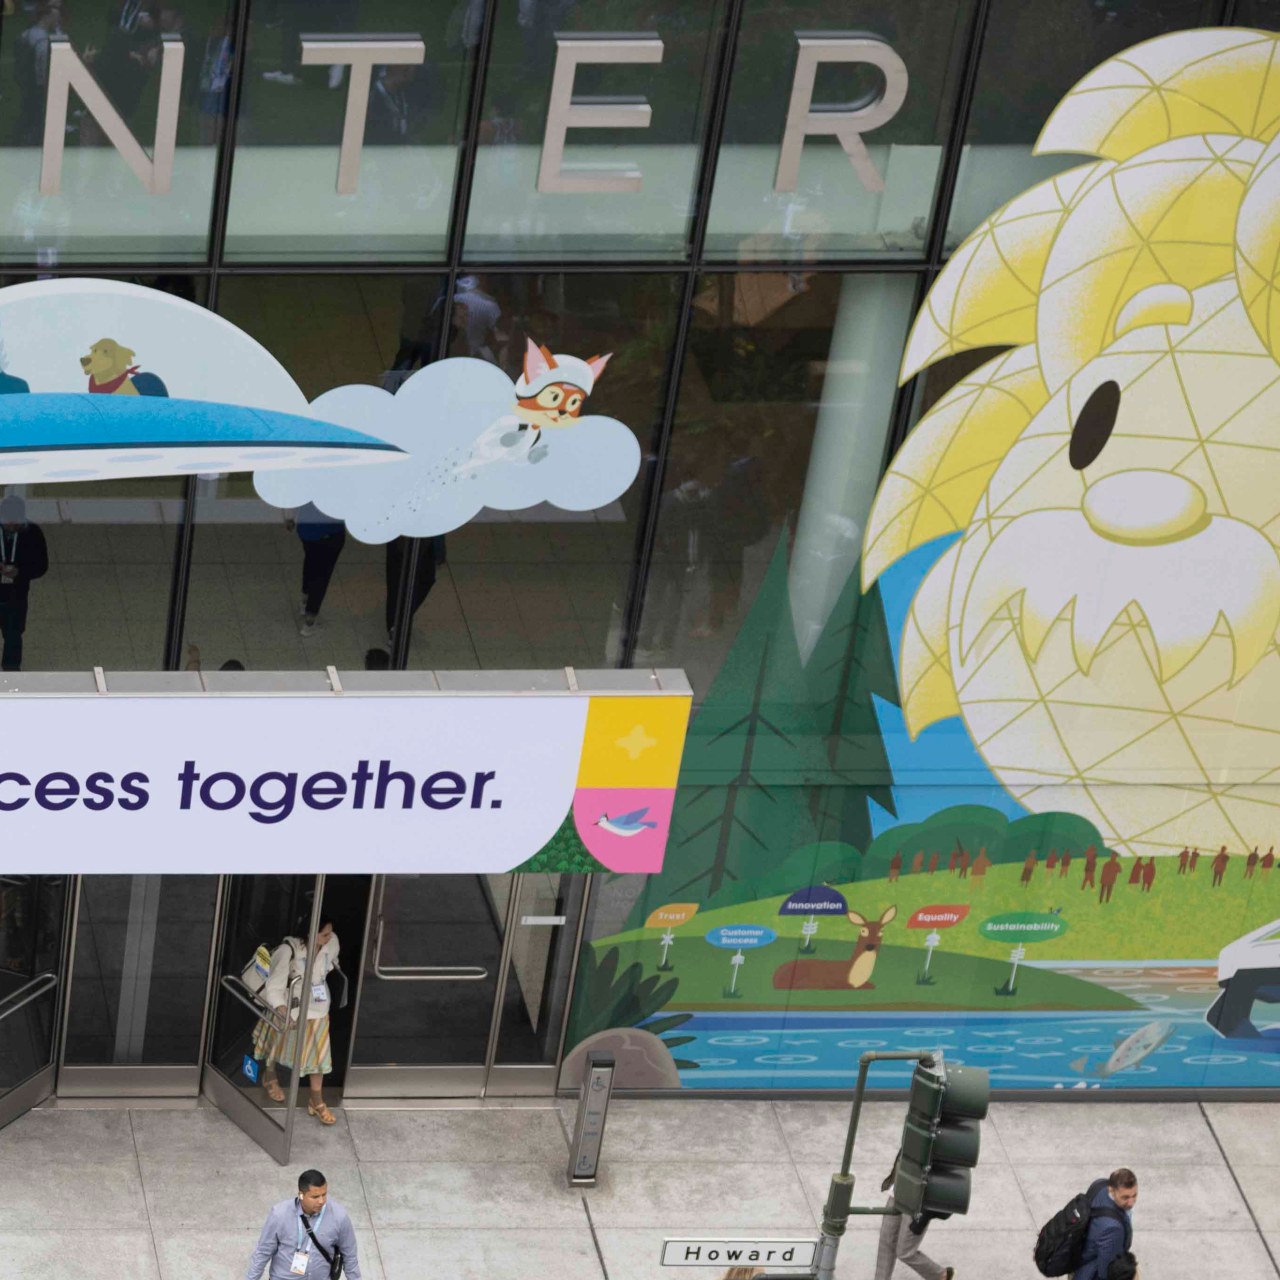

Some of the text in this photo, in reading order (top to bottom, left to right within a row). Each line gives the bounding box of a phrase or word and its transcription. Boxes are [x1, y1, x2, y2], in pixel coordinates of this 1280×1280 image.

[178, 760, 503, 824] together.
[787, 900, 843, 912] Innovation
[658, 911, 686, 920] Trust
[917, 911, 960, 924] Equality
[985, 919, 1061, 933] Sustainability
[720, 928, 764, 938] Customer
[720, 936, 759, 945] Success
[684, 1246, 795, 1262] Howard
